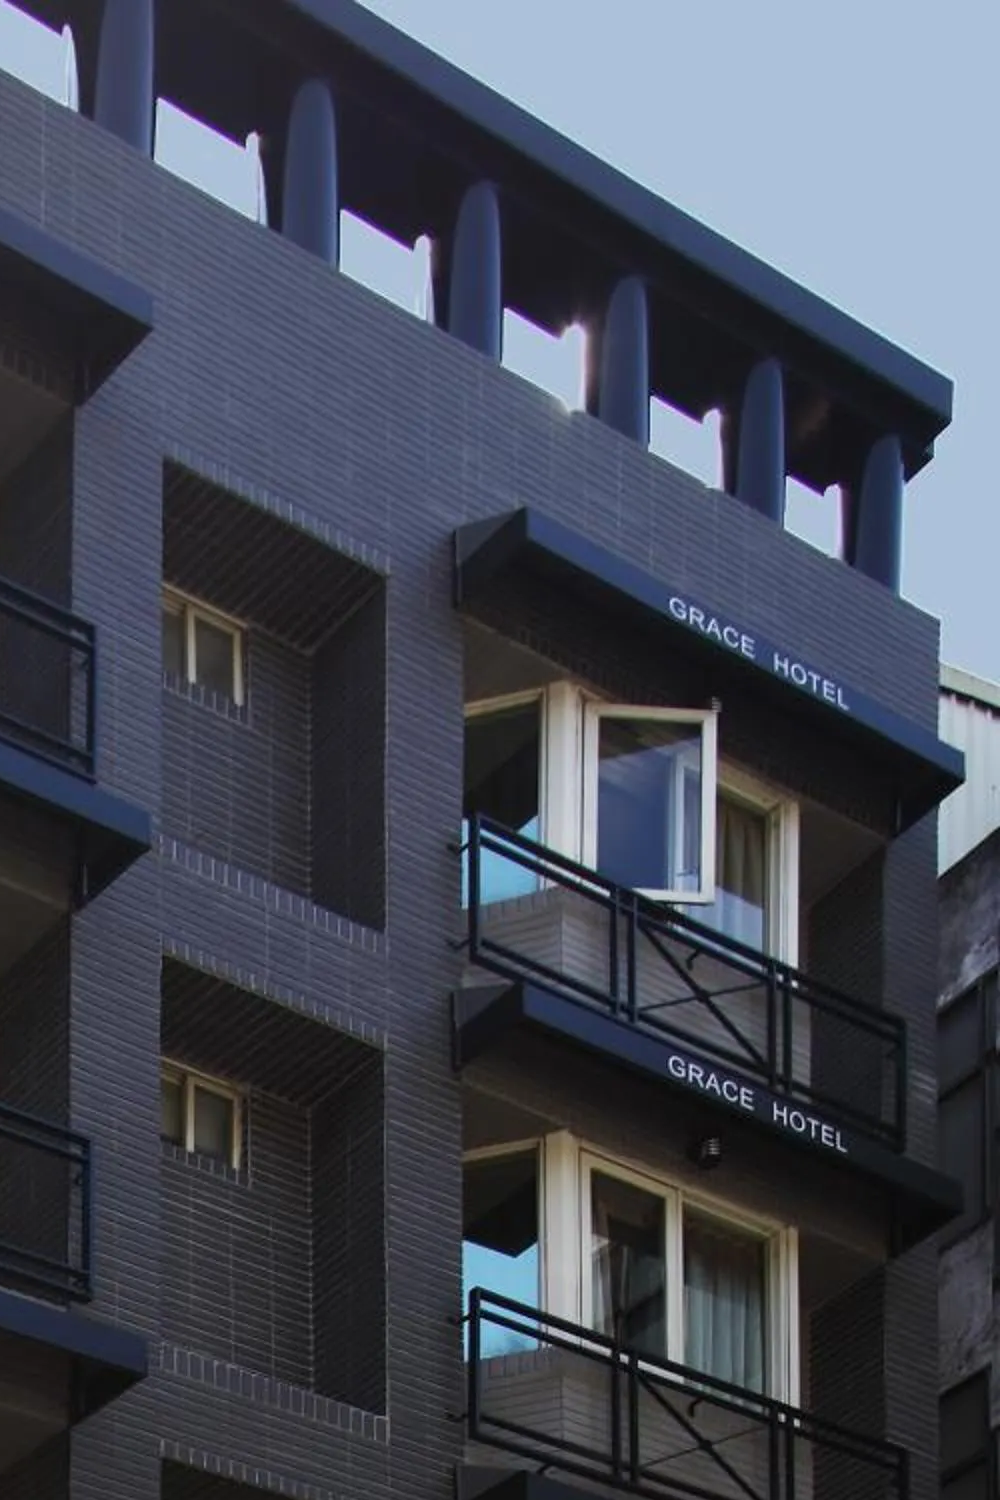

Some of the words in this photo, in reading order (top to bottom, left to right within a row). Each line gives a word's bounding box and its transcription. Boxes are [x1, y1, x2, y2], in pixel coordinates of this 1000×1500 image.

[668, 597, 755, 659] GRACE
[774, 653, 850, 711] HOTEL
[668, 1055, 755, 1111] GRACE
[773, 1101, 848, 1153] HOTEL
